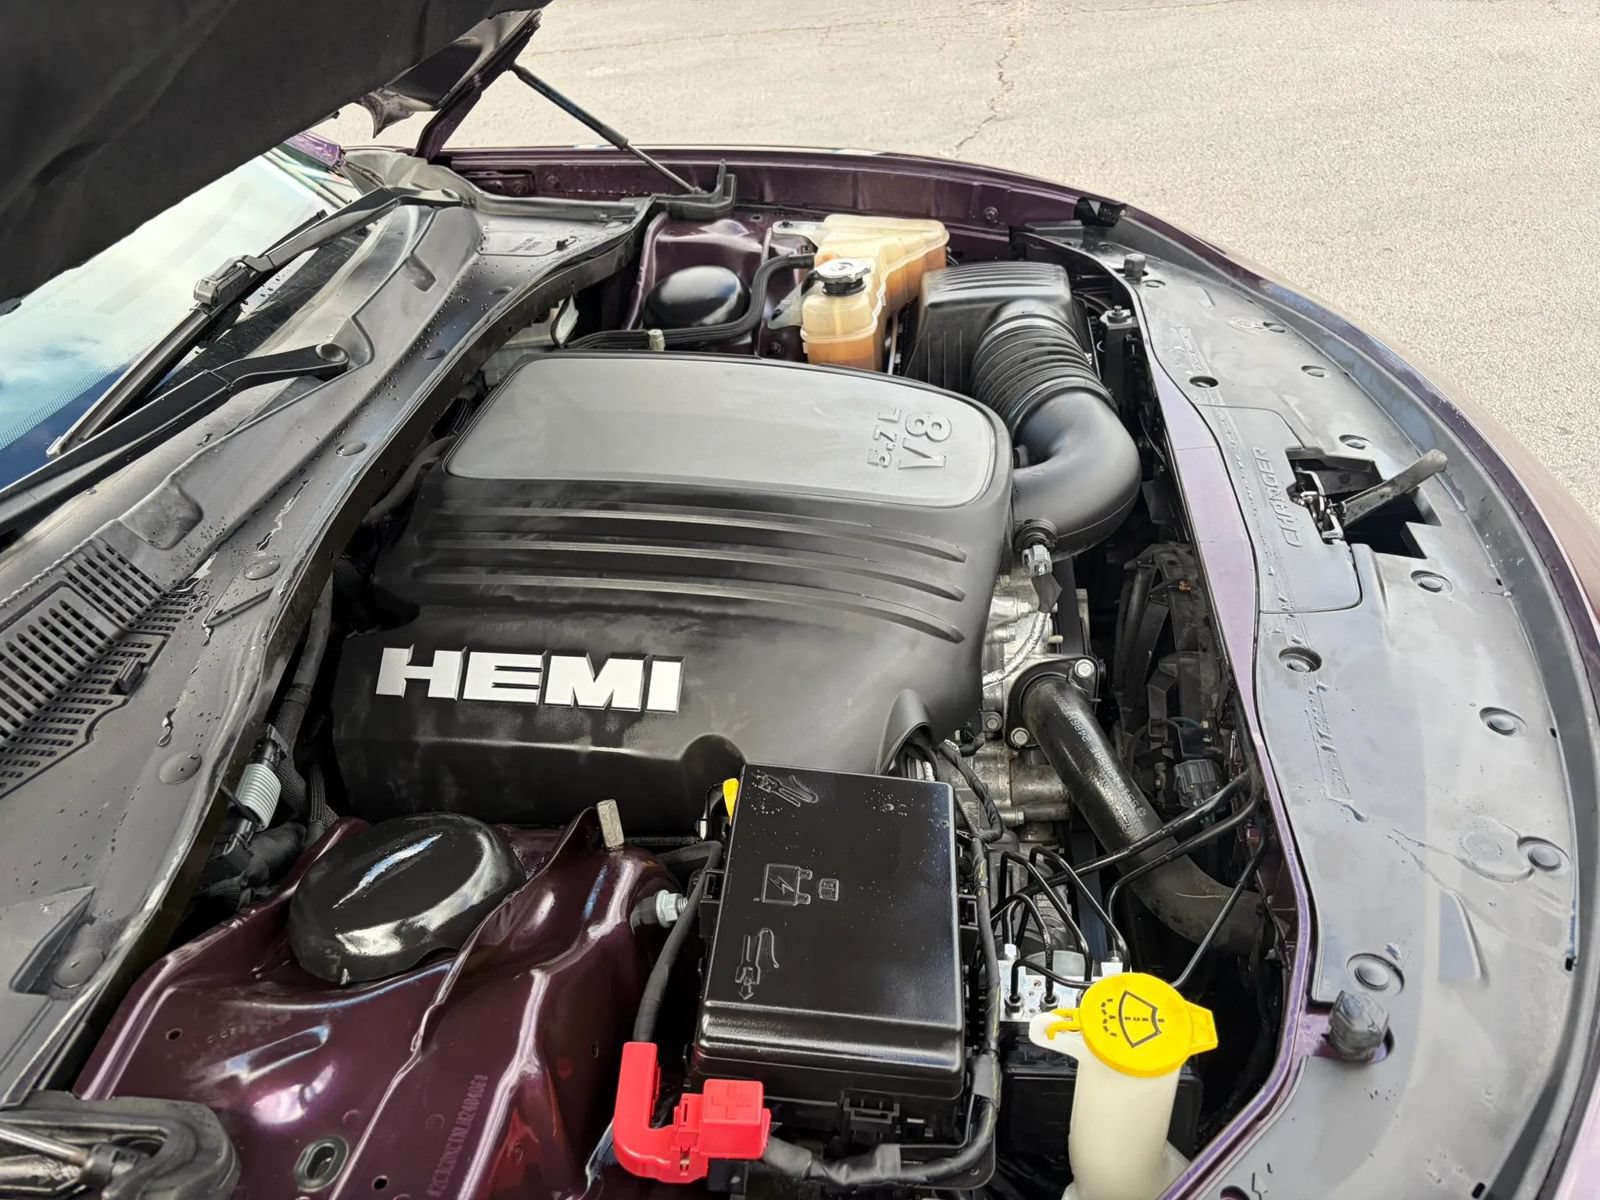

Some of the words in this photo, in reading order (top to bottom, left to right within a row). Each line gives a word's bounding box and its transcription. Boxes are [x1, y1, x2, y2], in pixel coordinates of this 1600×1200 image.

[867, 408, 902, 468] 5.7L
[898, 411, 953, 470] V8
[1252, 447, 1303, 548] CHARGER
[376, 643, 686, 713] HEMI
